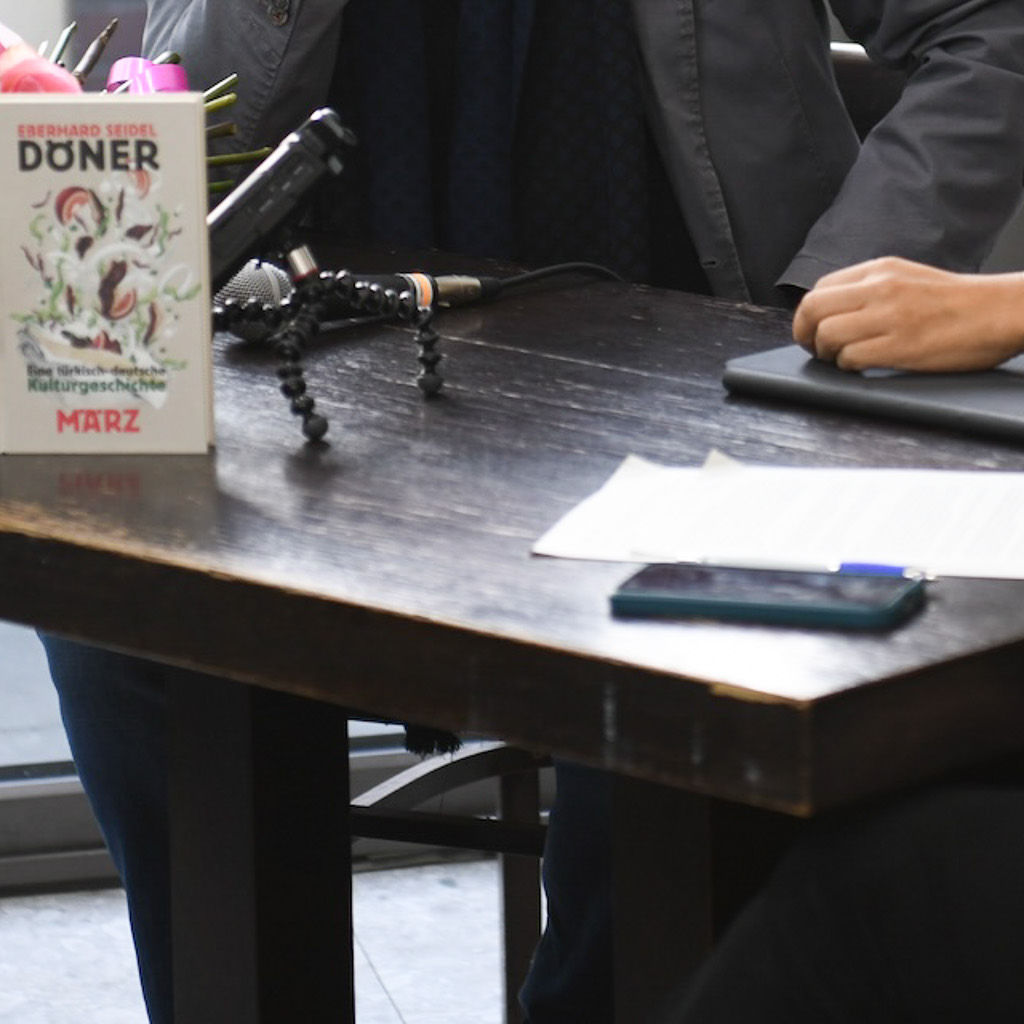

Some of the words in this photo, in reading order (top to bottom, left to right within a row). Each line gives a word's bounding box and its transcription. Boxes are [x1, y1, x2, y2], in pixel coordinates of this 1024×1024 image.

[18, 124, 100, 138] EBERHARD
[105, 123, 157, 138] SEIDEL
[19, 139, 160, 172] DÖNER
[27, 364, 53, 376] Eine
[27, 377, 166, 395] Kulturgeschichte
[56, 409, 140, 434] MÄRZ
